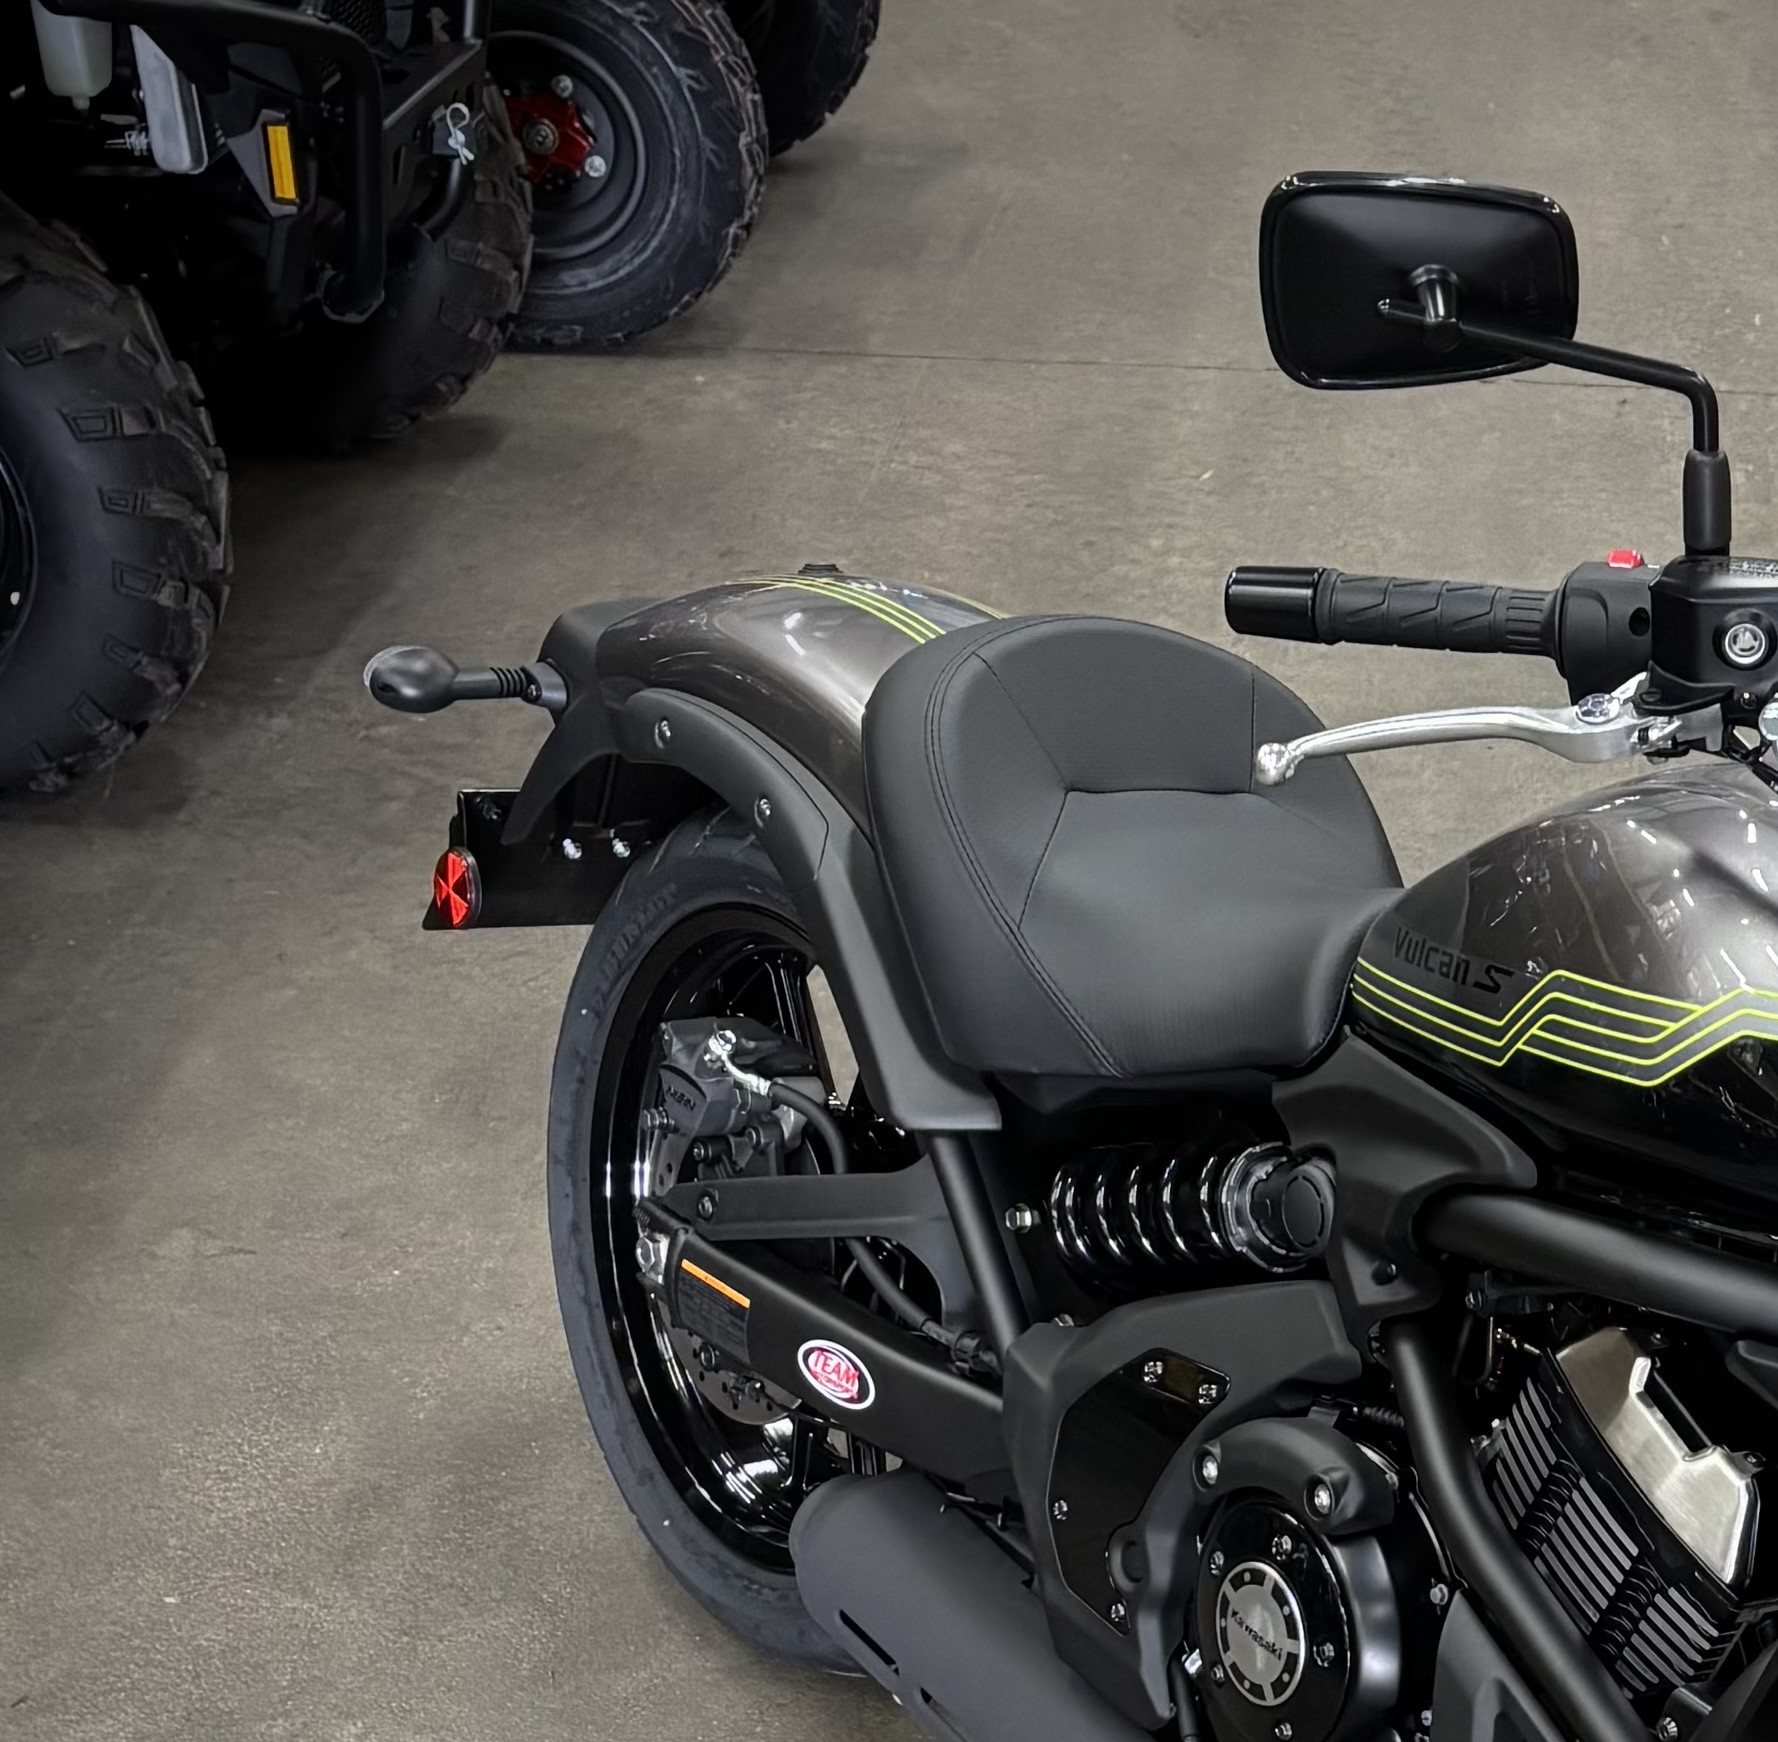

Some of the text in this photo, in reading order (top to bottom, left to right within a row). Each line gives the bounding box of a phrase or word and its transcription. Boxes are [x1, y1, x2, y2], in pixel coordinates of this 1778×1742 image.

[1394, 926, 1516, 995] Vulcan S
[813, 1348, 860, 1388] TEAM
[1230, 1608, 1283, 1661] Kawasaki
